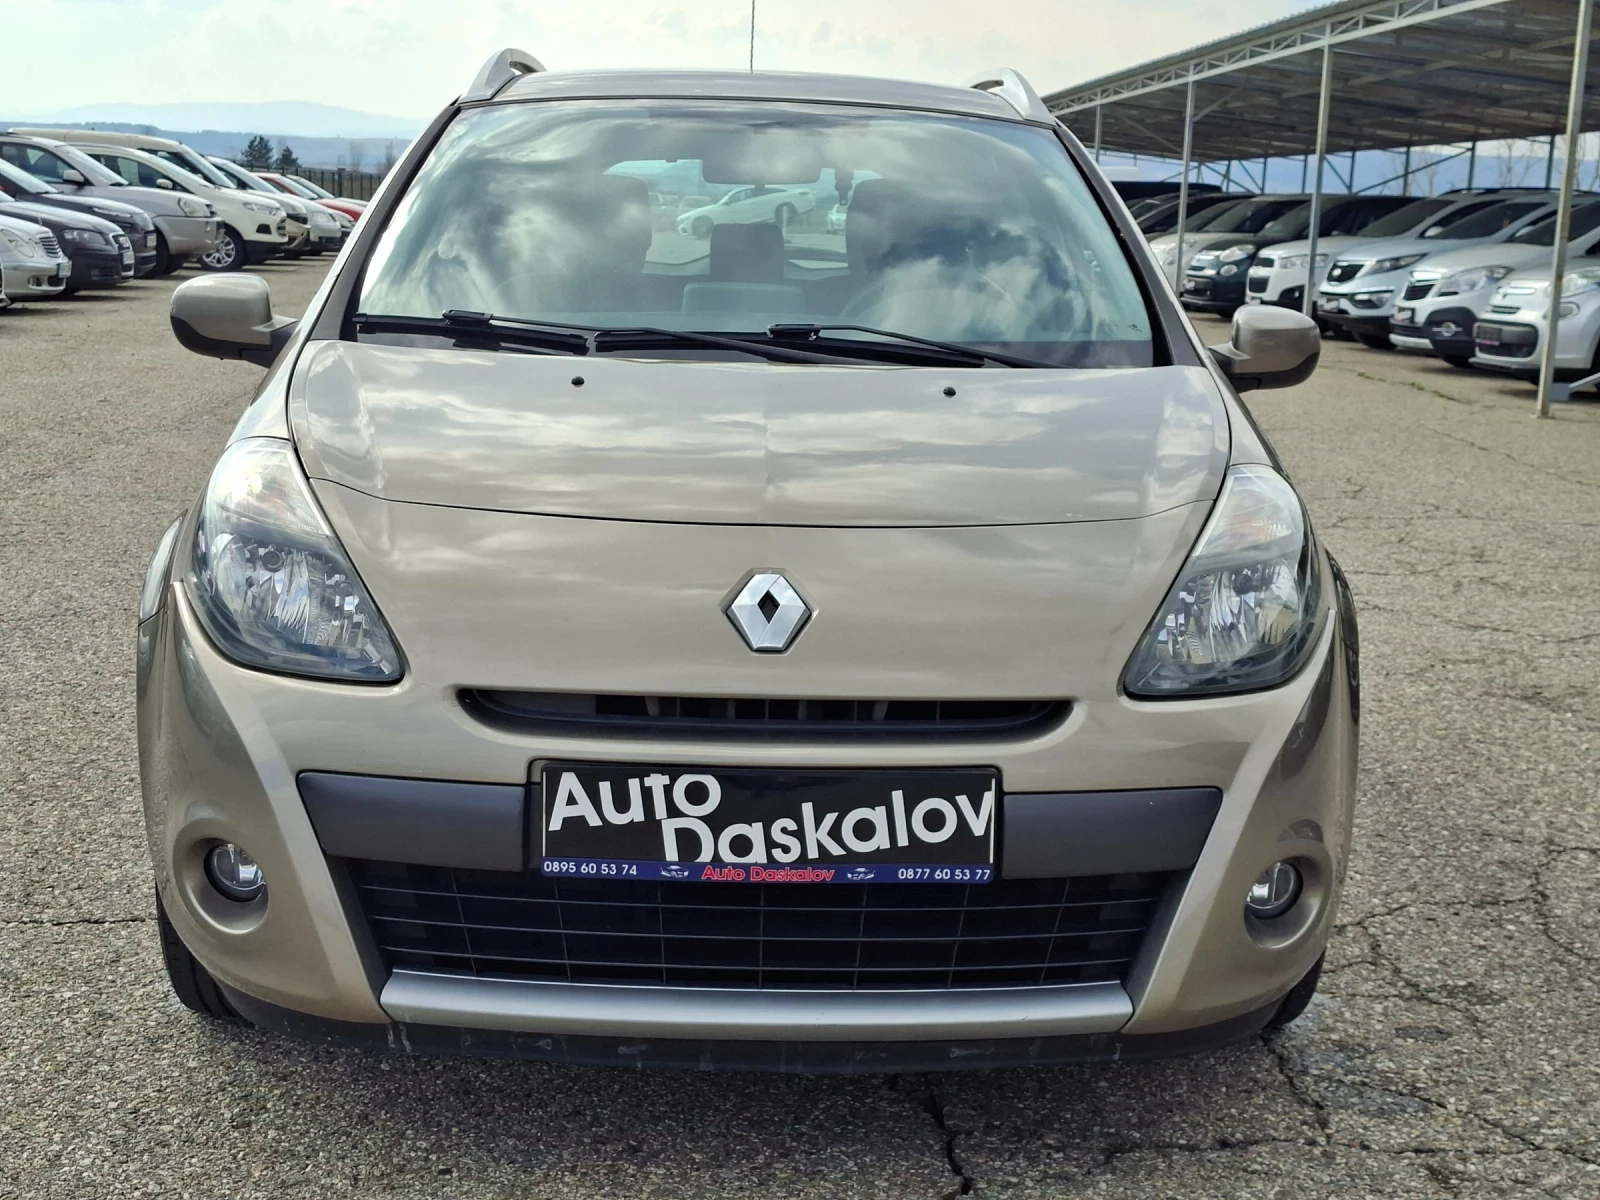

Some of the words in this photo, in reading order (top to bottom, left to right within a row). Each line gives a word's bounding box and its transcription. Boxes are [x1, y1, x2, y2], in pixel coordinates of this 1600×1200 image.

[548, 771, 722, 831] Auto
[662, 790, 993, 864] Daskalov
[543, 861, 577, 873] 0895
[580, 863, 597, 874] 60
[600, 864, 617, 875] 53
[621, 864, 638, 876] 74
[701, 865, 746, 880] Auto
[750, 866, 835, 882] Daskalov
[898, 868, 930, 879] 0877
[934, 868, 951, 879] 60
[954, 869, 971, 880] 53
[975, 869, 991, 880] 77
